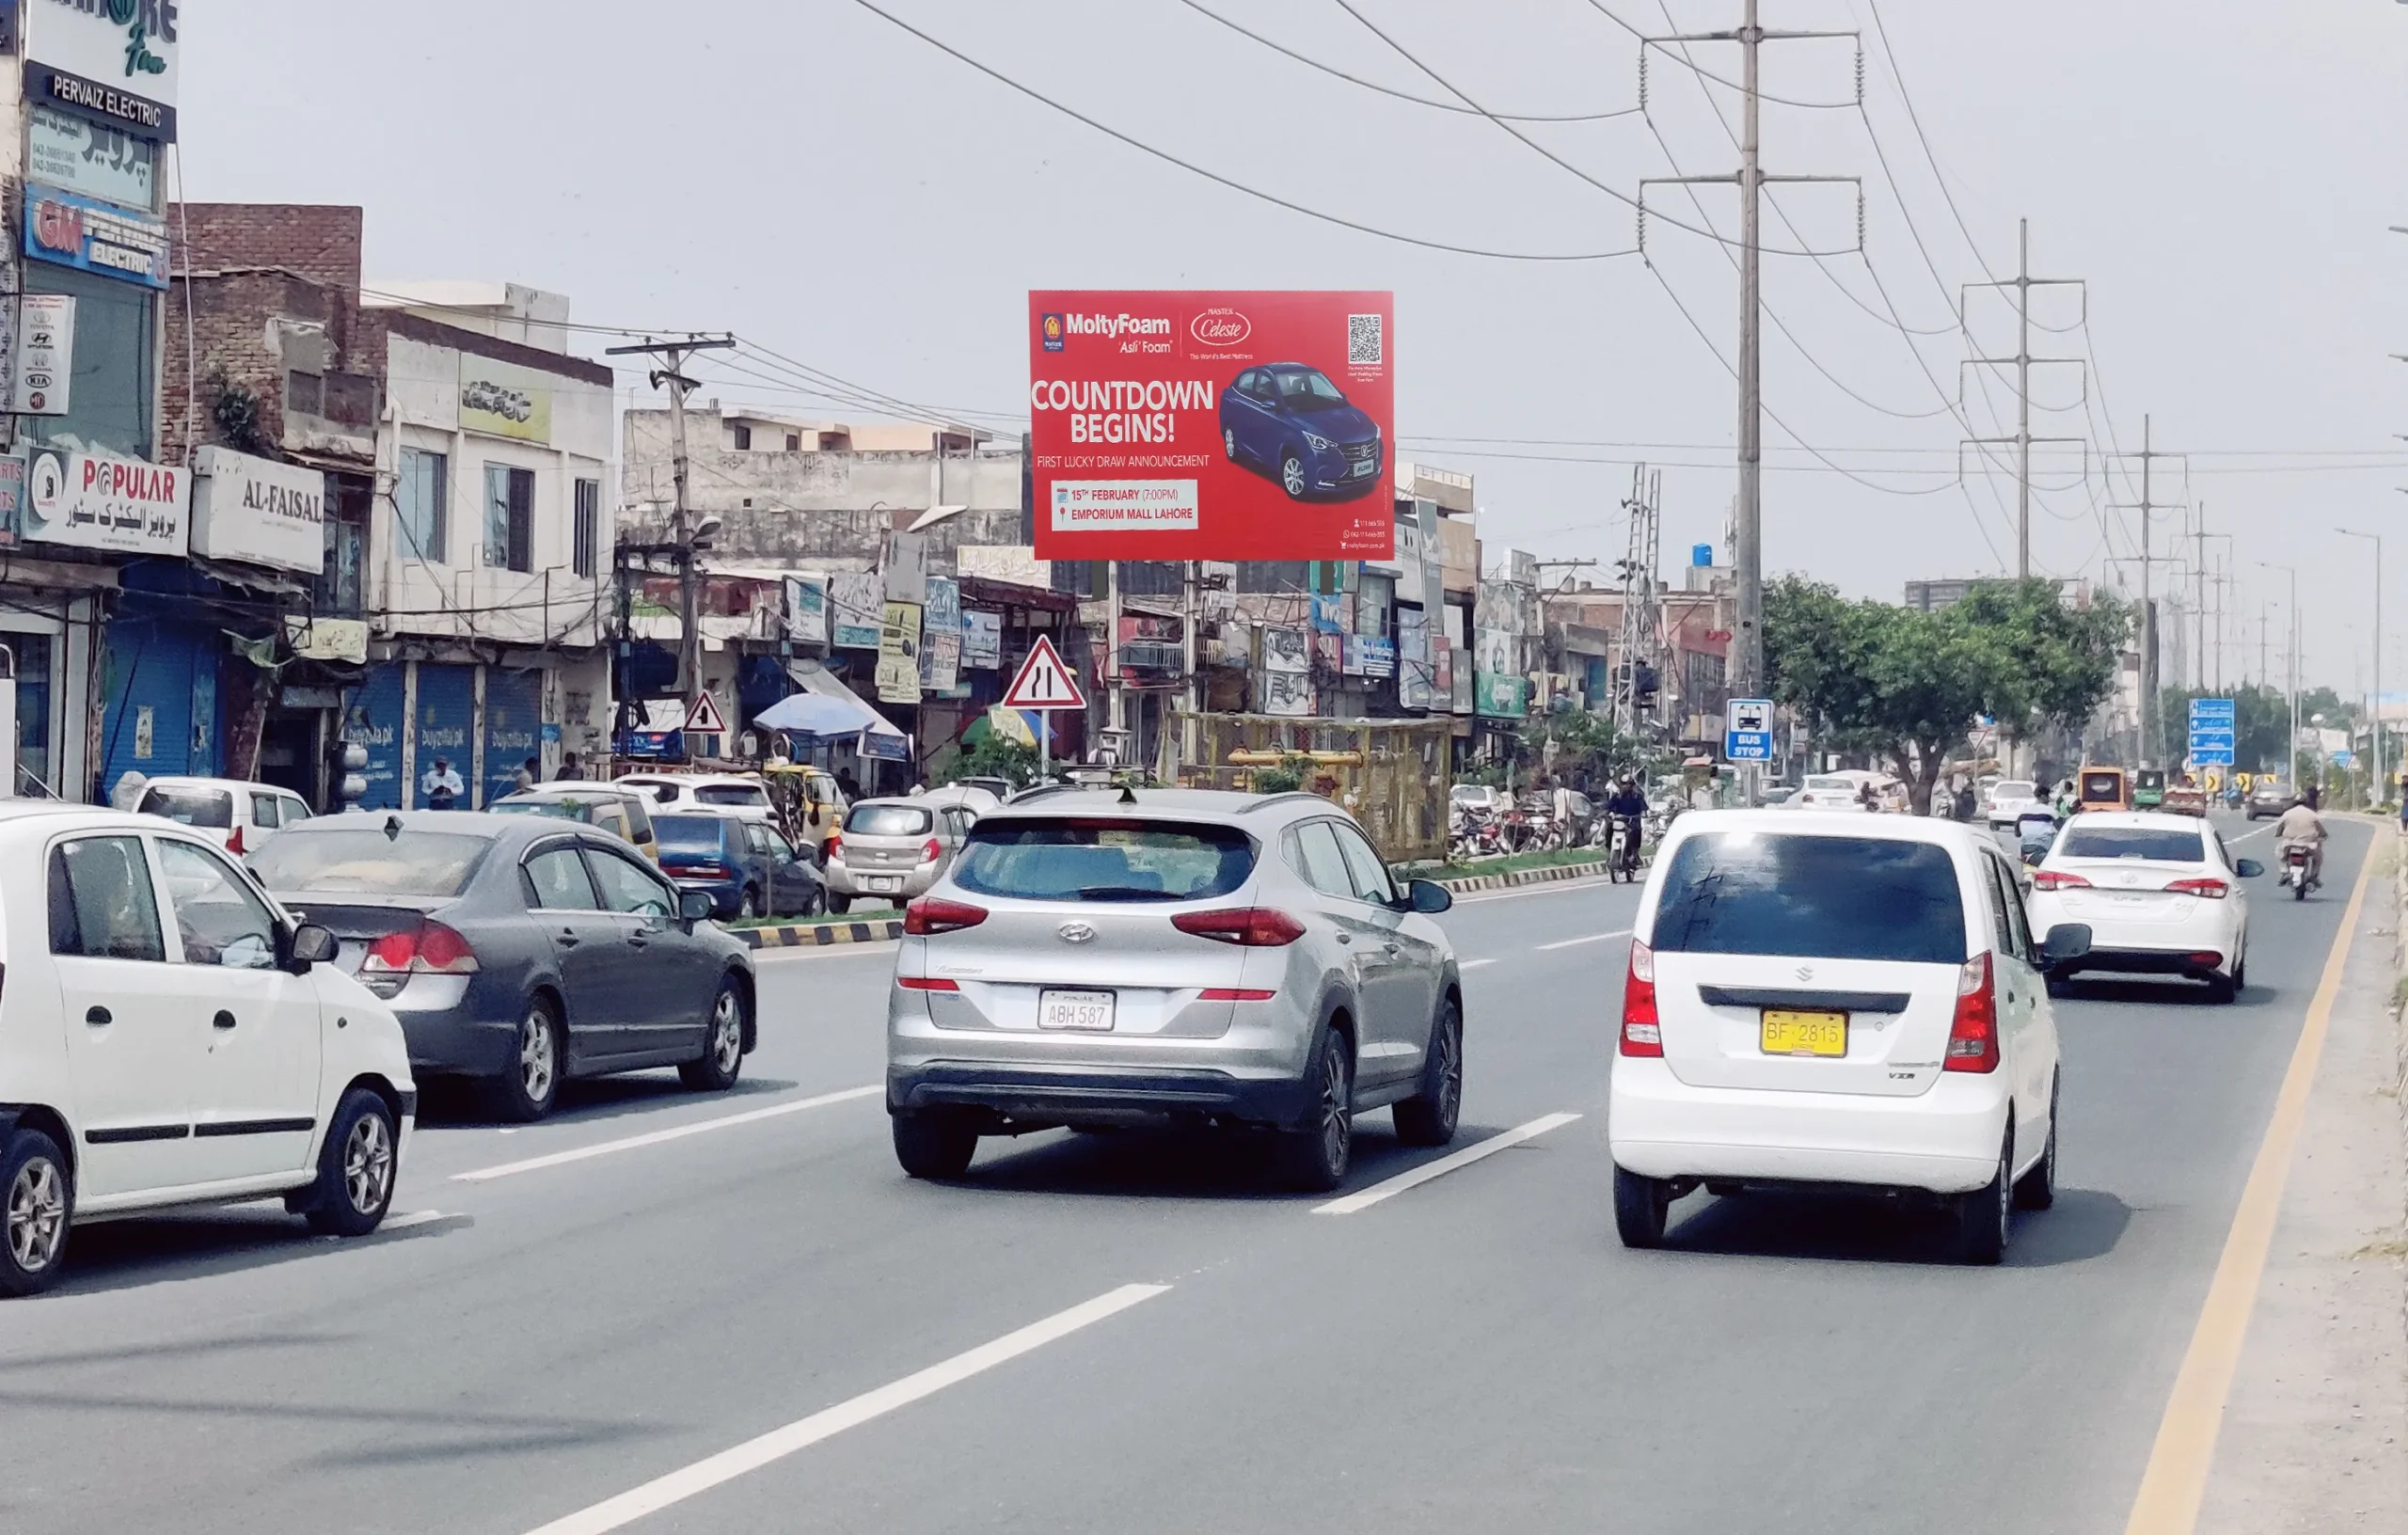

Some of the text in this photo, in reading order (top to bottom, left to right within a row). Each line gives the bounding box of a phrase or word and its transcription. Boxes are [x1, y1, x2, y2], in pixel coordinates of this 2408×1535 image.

[54, 73, 103, 111] PERVAIZ
[105, 91, 162, 128] ELECTRIC
[89, 241, 152, 275] ELECTRIC
[1066, 313, 1170, 339] MoltyFoam
[1200, 319, 1242, 337] Celeste
[29, 377, 48, 387] KIA
[1031, 379, 1213, 411] COUNTDOWN
[1070, 412, 1175, 444] BEGINS!
[1037, 454, 1211, 467] FIRST LUCKY DRAW ANNOUNCEMENT
[83, 459, 176, 504] POPULAR
[1071, 488, 1180, 501] 15TH FEBRUARY (7:00PM)
[1071, 507, 1194, 521] EMPORIUM MALL LAHORE
[1737, 734, 1761, 745] BUS
[1734, 746, 1765, 757] STOP
[1048, 1005, 1105, 1025] ABH 587
[1766, 1021, 1839, 1043] BF 2815
